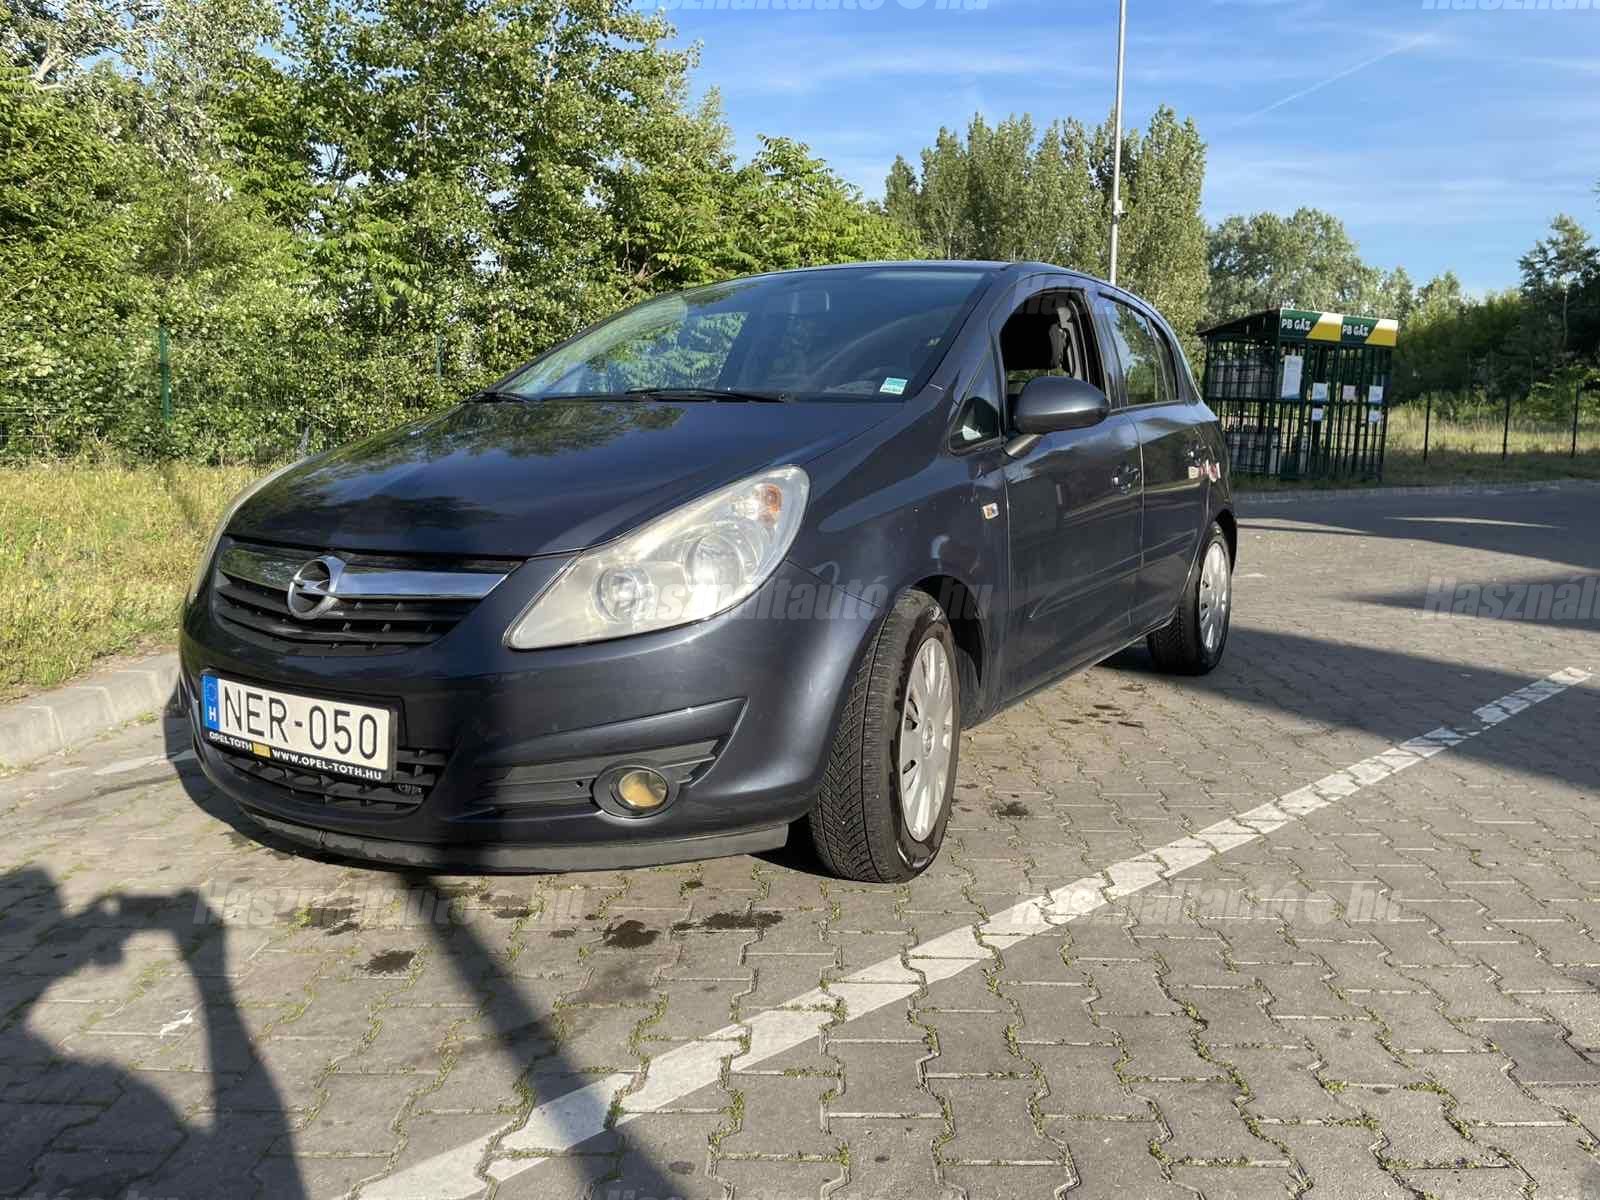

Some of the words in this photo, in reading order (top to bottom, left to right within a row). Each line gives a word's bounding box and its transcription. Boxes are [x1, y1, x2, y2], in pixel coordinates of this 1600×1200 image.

[1281, 318, 1293, 329] PB
[1342, 324, 1352, 335] PB
[208, 706, 217, 722] H
[224, 685, 377, 760] NER-050
